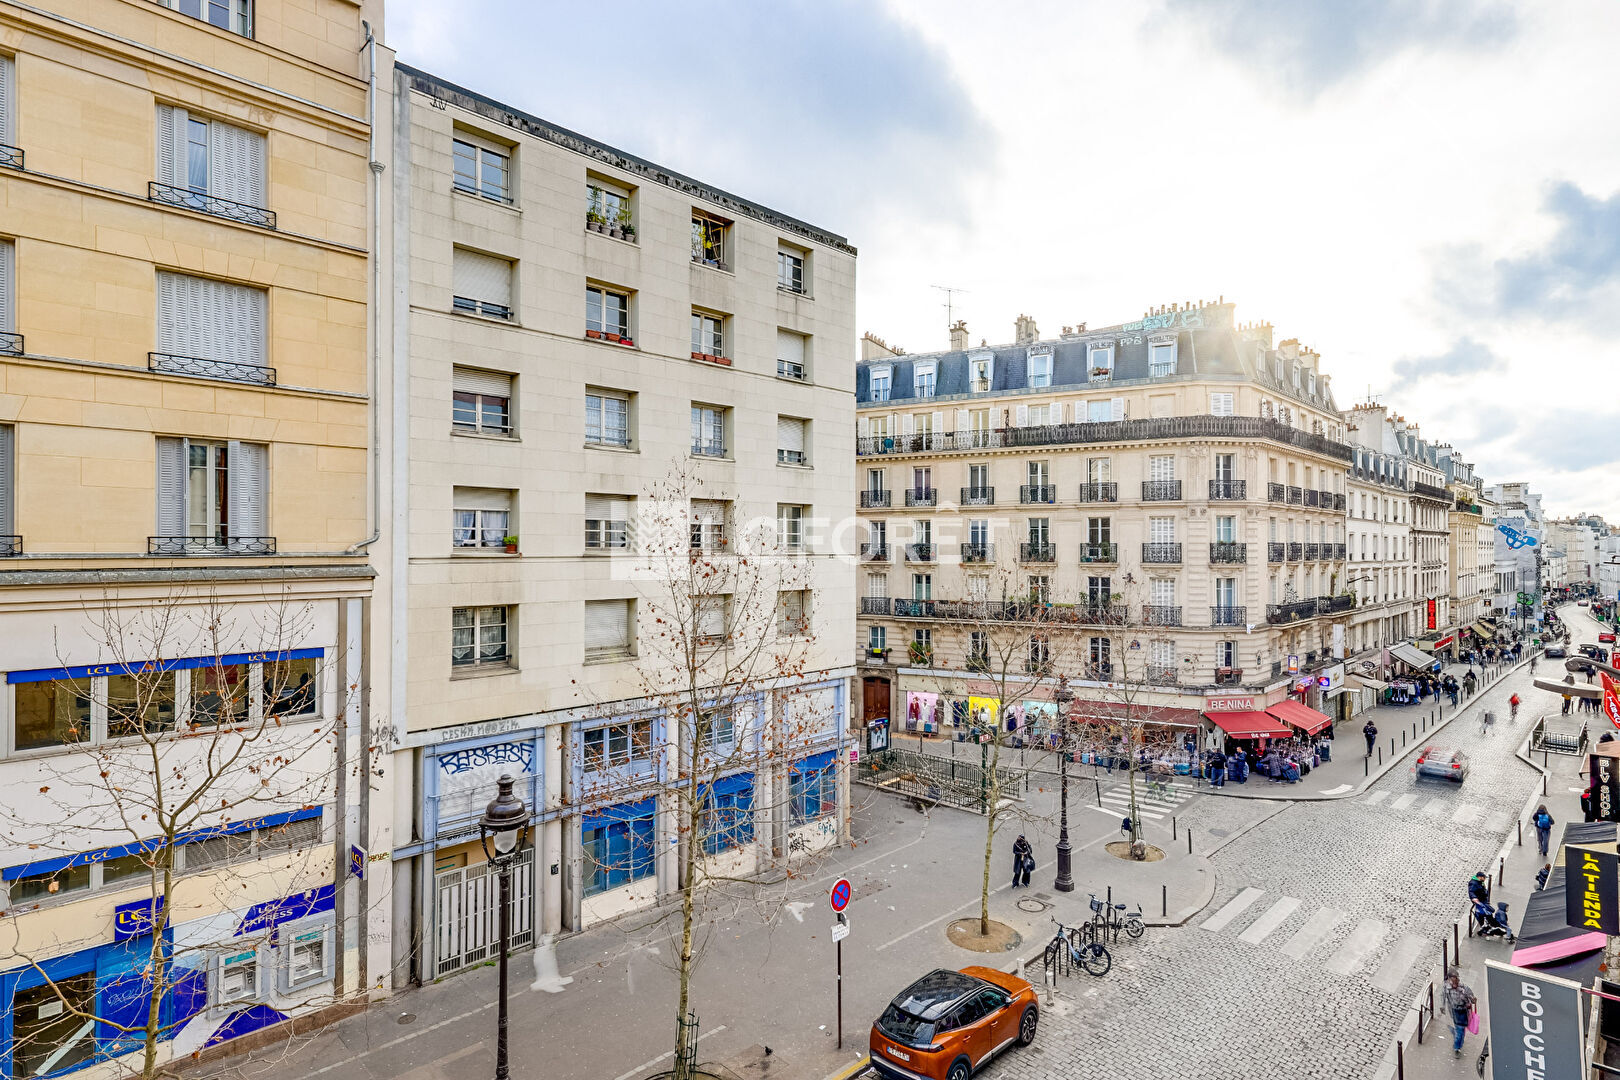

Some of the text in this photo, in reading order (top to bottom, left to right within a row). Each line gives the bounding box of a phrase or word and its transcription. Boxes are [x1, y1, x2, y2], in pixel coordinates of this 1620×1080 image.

[247, 653, 270, 662] LCL
[87, 666, 114, 676] LCL
[1211, 699, 1252, 709] BE NINA
[1600, 759, 1611, 818] BLV SHOP
[246, 818, 269, 829] LCL
[84, 851, 111, 862] LCL
[351, 851, 362, 867] LCL
[1582, 853, 1602, 929] LA TIENDA
[1520, 981, 1546, 1080] BOUCHE
